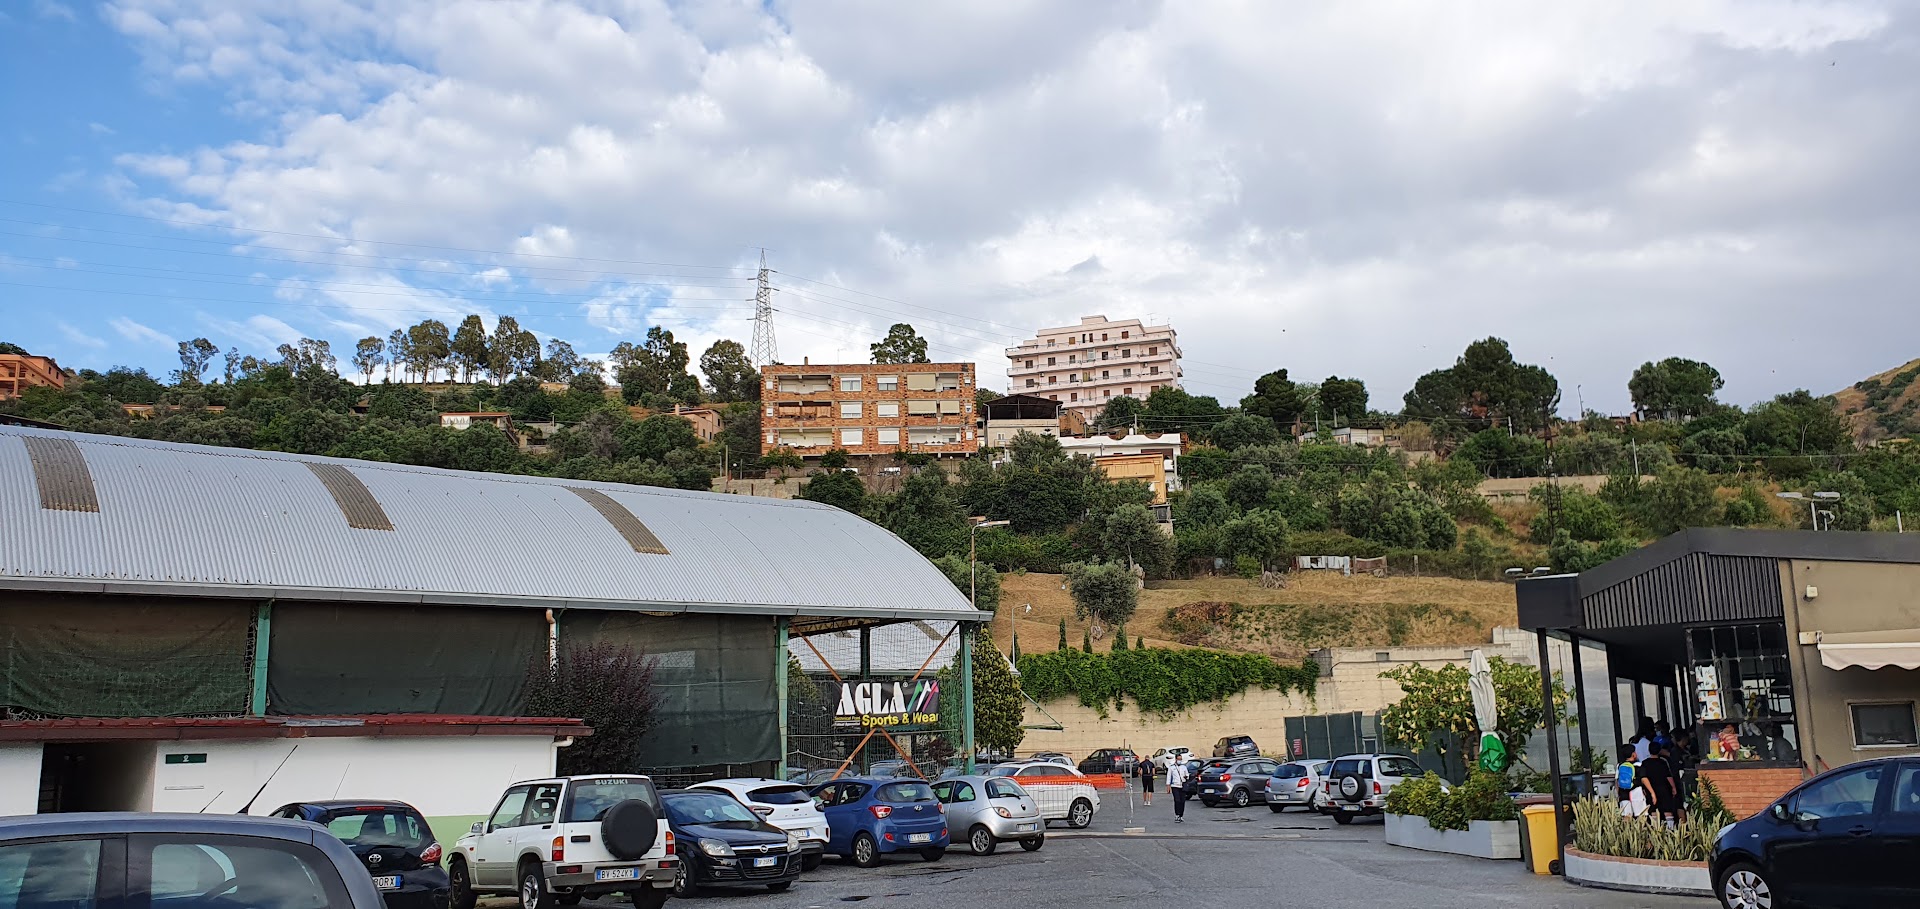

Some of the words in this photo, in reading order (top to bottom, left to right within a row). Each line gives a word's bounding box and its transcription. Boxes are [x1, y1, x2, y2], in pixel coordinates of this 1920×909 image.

[836, 681, 907, 715] AGLA
[861, 713, 899, 727] Sports
[902, 712, 909, 723] &
[182, 754, 190, 762] 2
